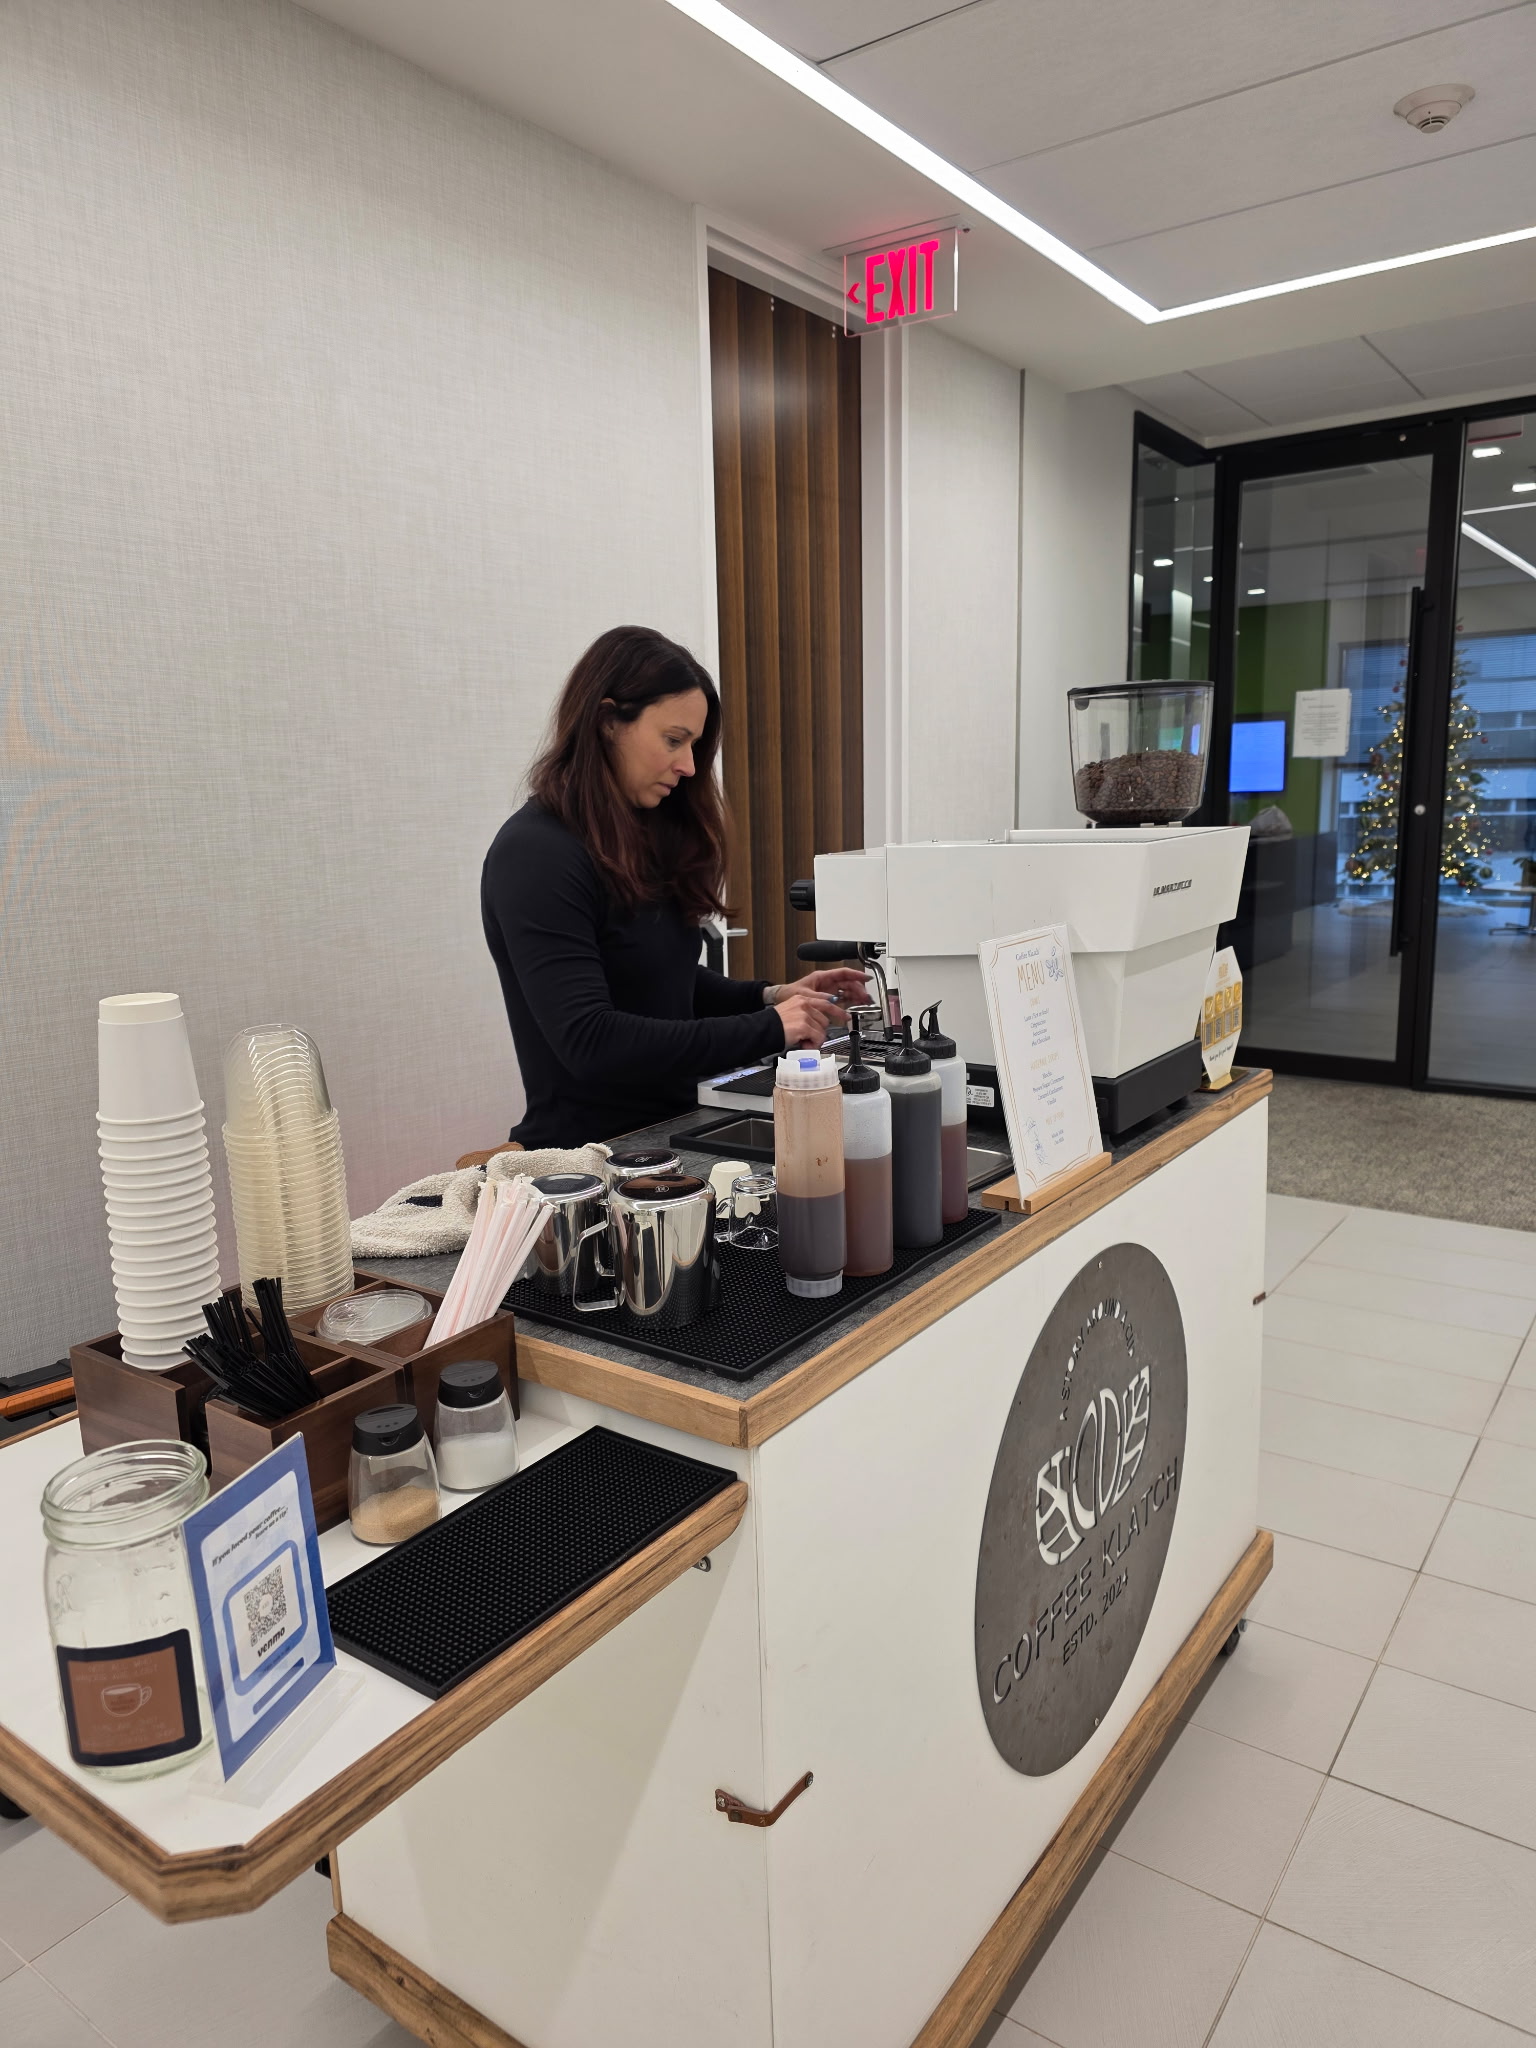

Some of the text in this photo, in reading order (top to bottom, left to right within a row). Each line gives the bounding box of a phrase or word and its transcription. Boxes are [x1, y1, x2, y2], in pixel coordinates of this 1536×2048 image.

[866, 239, 940, 324] EXIT
[1017, 960, 1044, 993] MENU
[1087, 1298, 1120, 1334] AROUND
[1125, 1323, 1134, 1357] CUP
[1062, 1327, 1084, 1400] STORY
[1060, 1407, 1068, 1421] A
[212, 1556, 219, 1567] If
[218, 1548, 231, 1564] you
[231, 1532, 248, 1551] loved
[248, 1522, 263, 1539] your
[993, 1456, 1178, 1704] COFFEE KLATCH
[1063, 1567, 1129, 1666] ESTD. 2024
[257, 1626, 285, 1658] venmo
